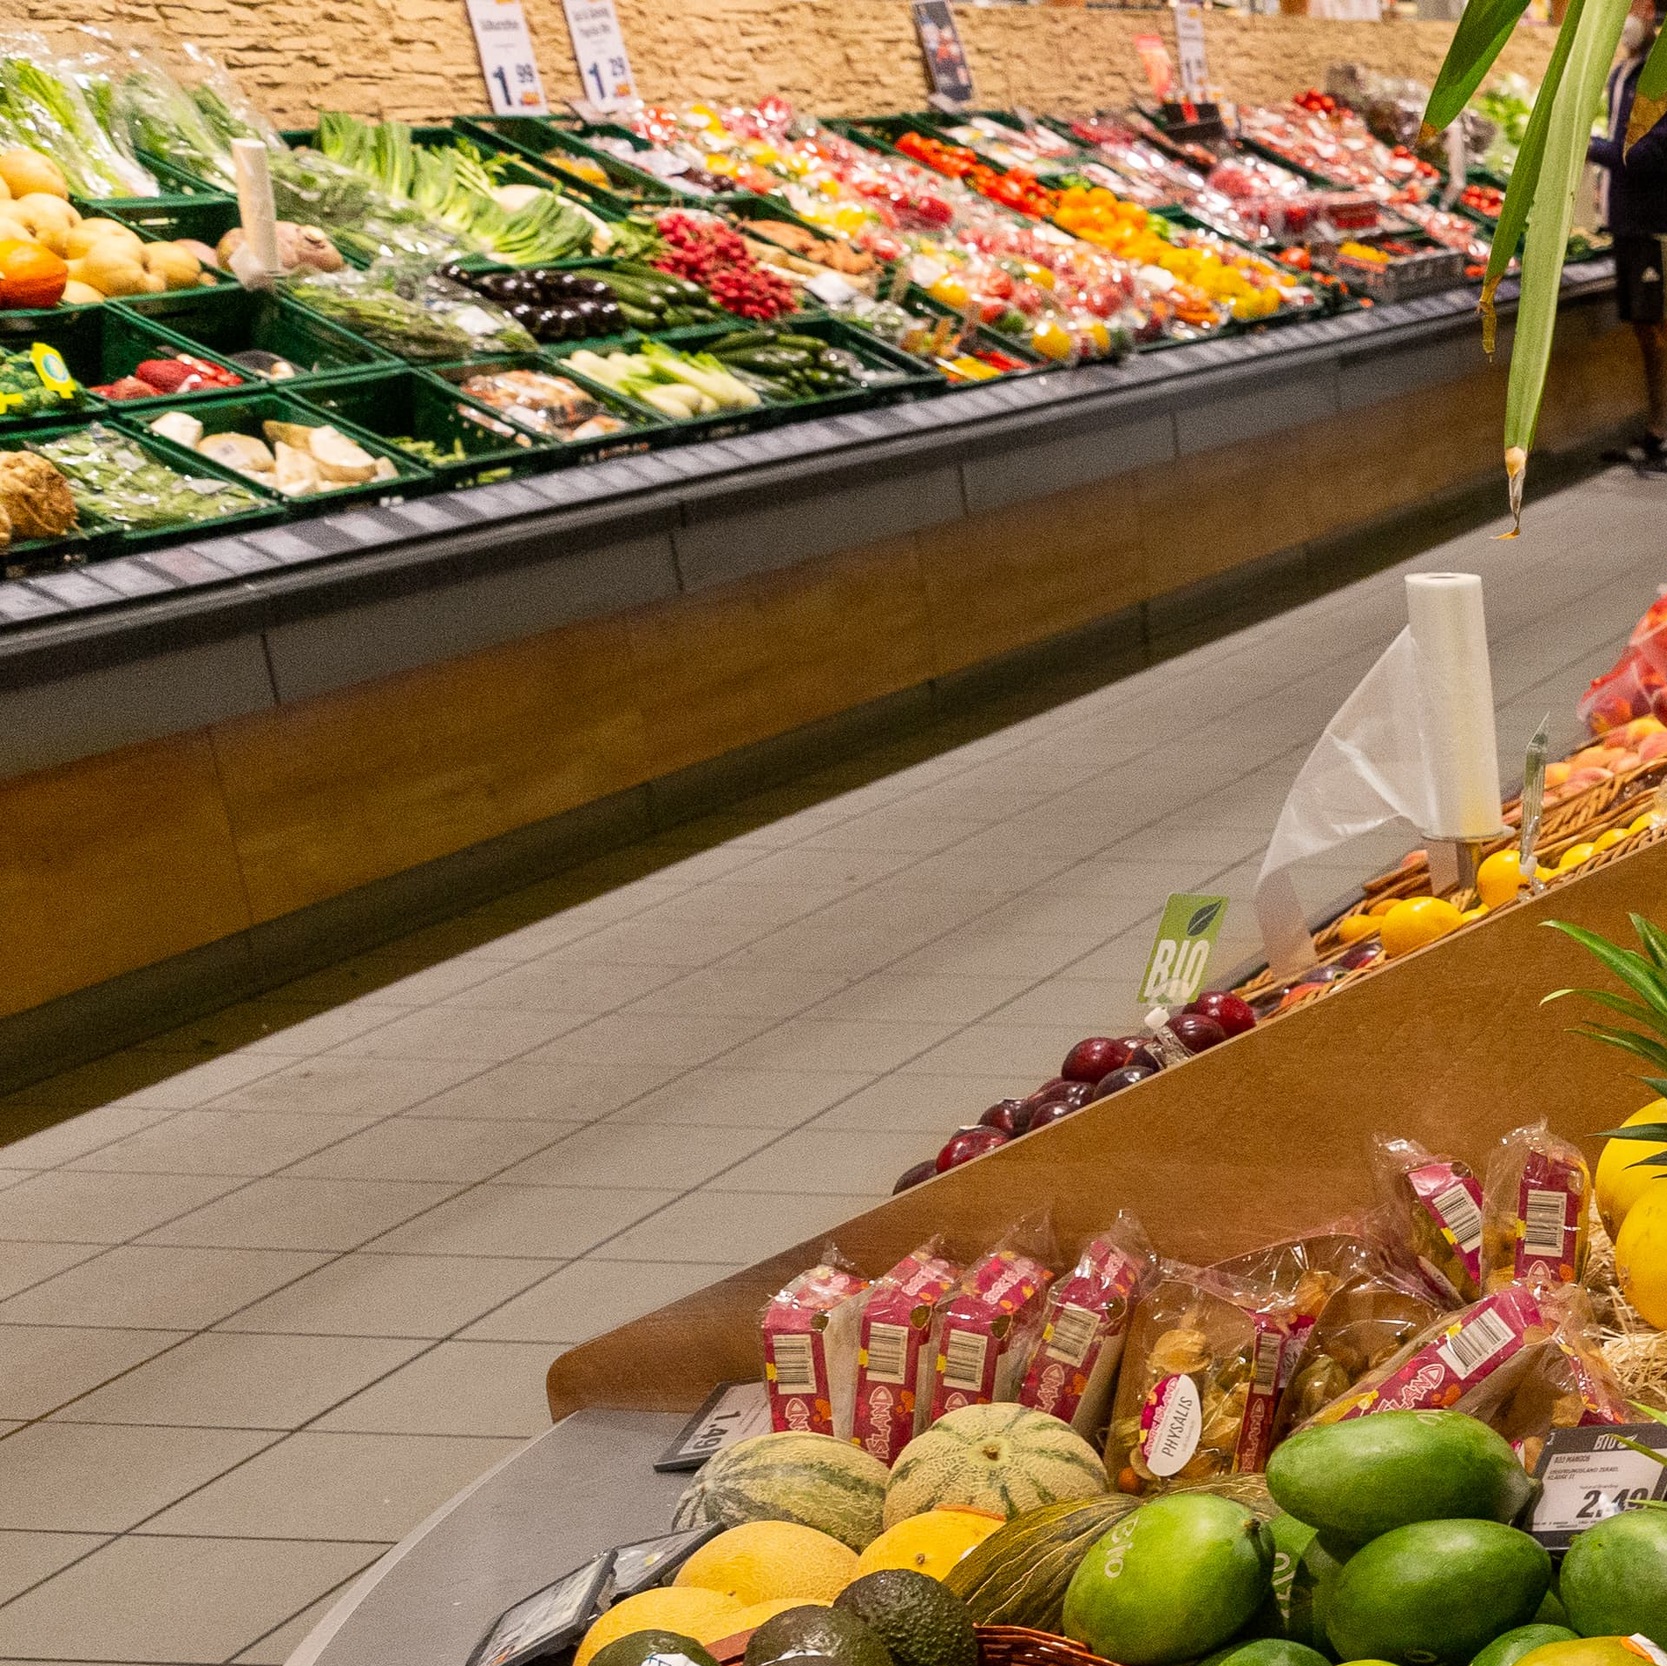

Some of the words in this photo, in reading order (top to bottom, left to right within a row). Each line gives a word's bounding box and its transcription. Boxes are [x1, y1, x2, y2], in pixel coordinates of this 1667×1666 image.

[1144, 939, 1210, 999] BIO
[1162, 1396, 1193, 1457] PHYSALIS
[1104, 1514, 1141, 1580] Bio
